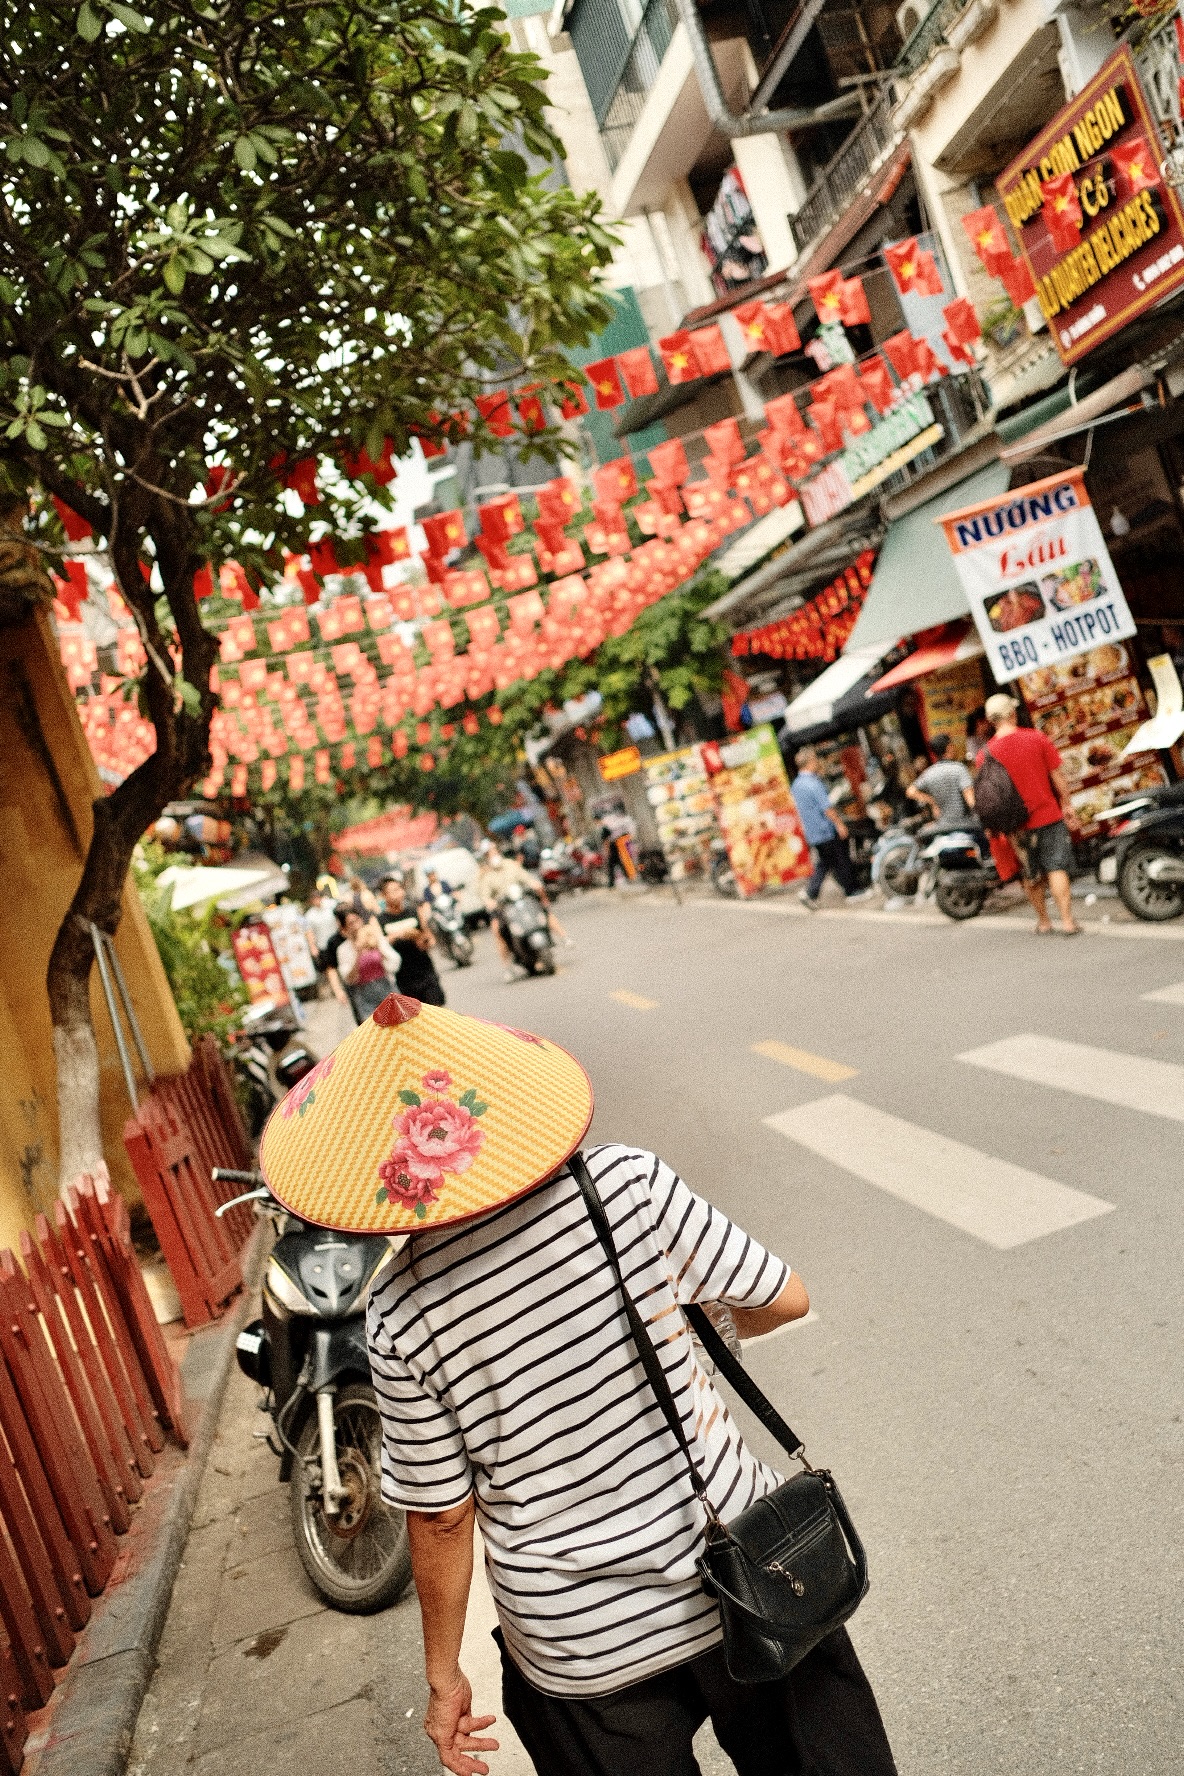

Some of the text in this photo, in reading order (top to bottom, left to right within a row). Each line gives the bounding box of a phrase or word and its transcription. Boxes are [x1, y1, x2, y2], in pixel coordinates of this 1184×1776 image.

[1073, 88, 1125, 160] NGON
[1050, 240, 1102, 309] QUARTER
[1090, 191, 1161, 275] DELICACIES
[998, 636, 1040, 671] BBQ
[1051, 604, 1121, 652] HOTPOT
